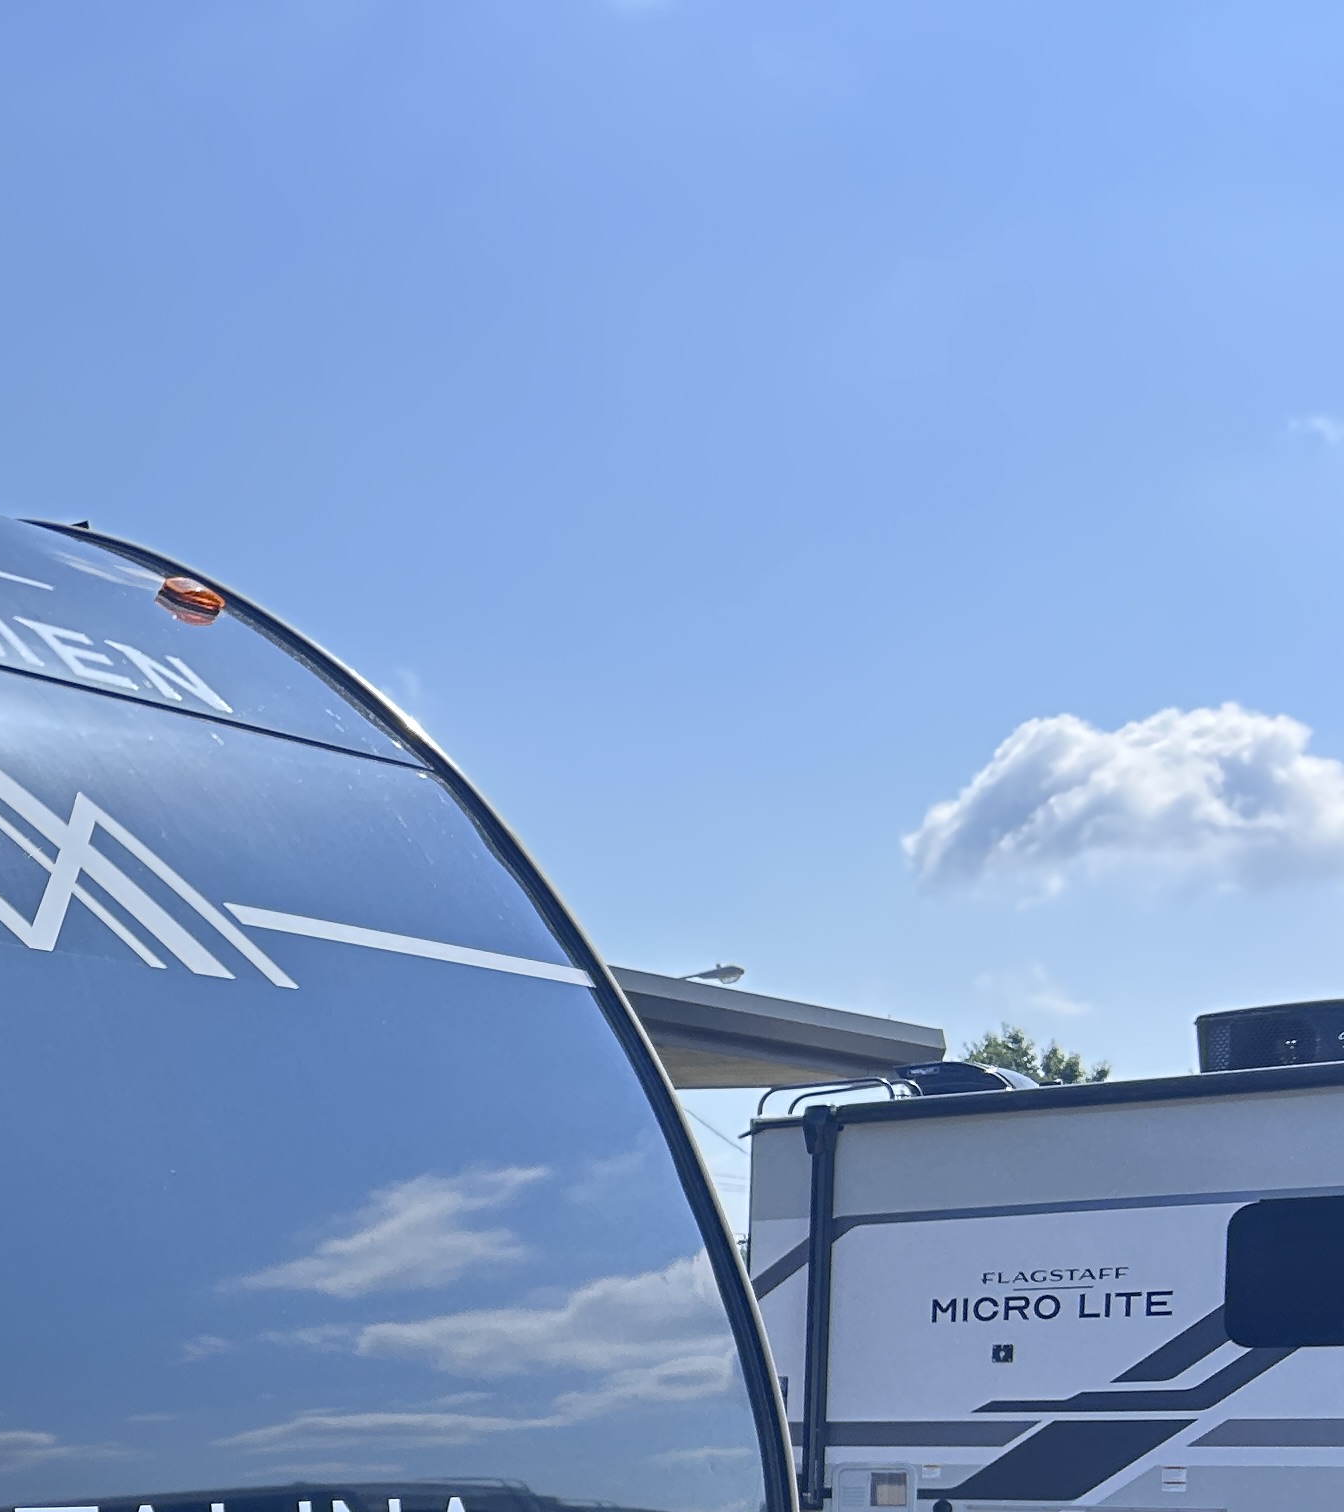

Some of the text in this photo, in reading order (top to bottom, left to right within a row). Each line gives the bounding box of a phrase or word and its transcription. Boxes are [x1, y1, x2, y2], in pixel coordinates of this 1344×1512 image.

[981, 1266, 1129, 1285] FLAGSTAFF
[930, 1290, 1174, 1324] MICRO LITE
